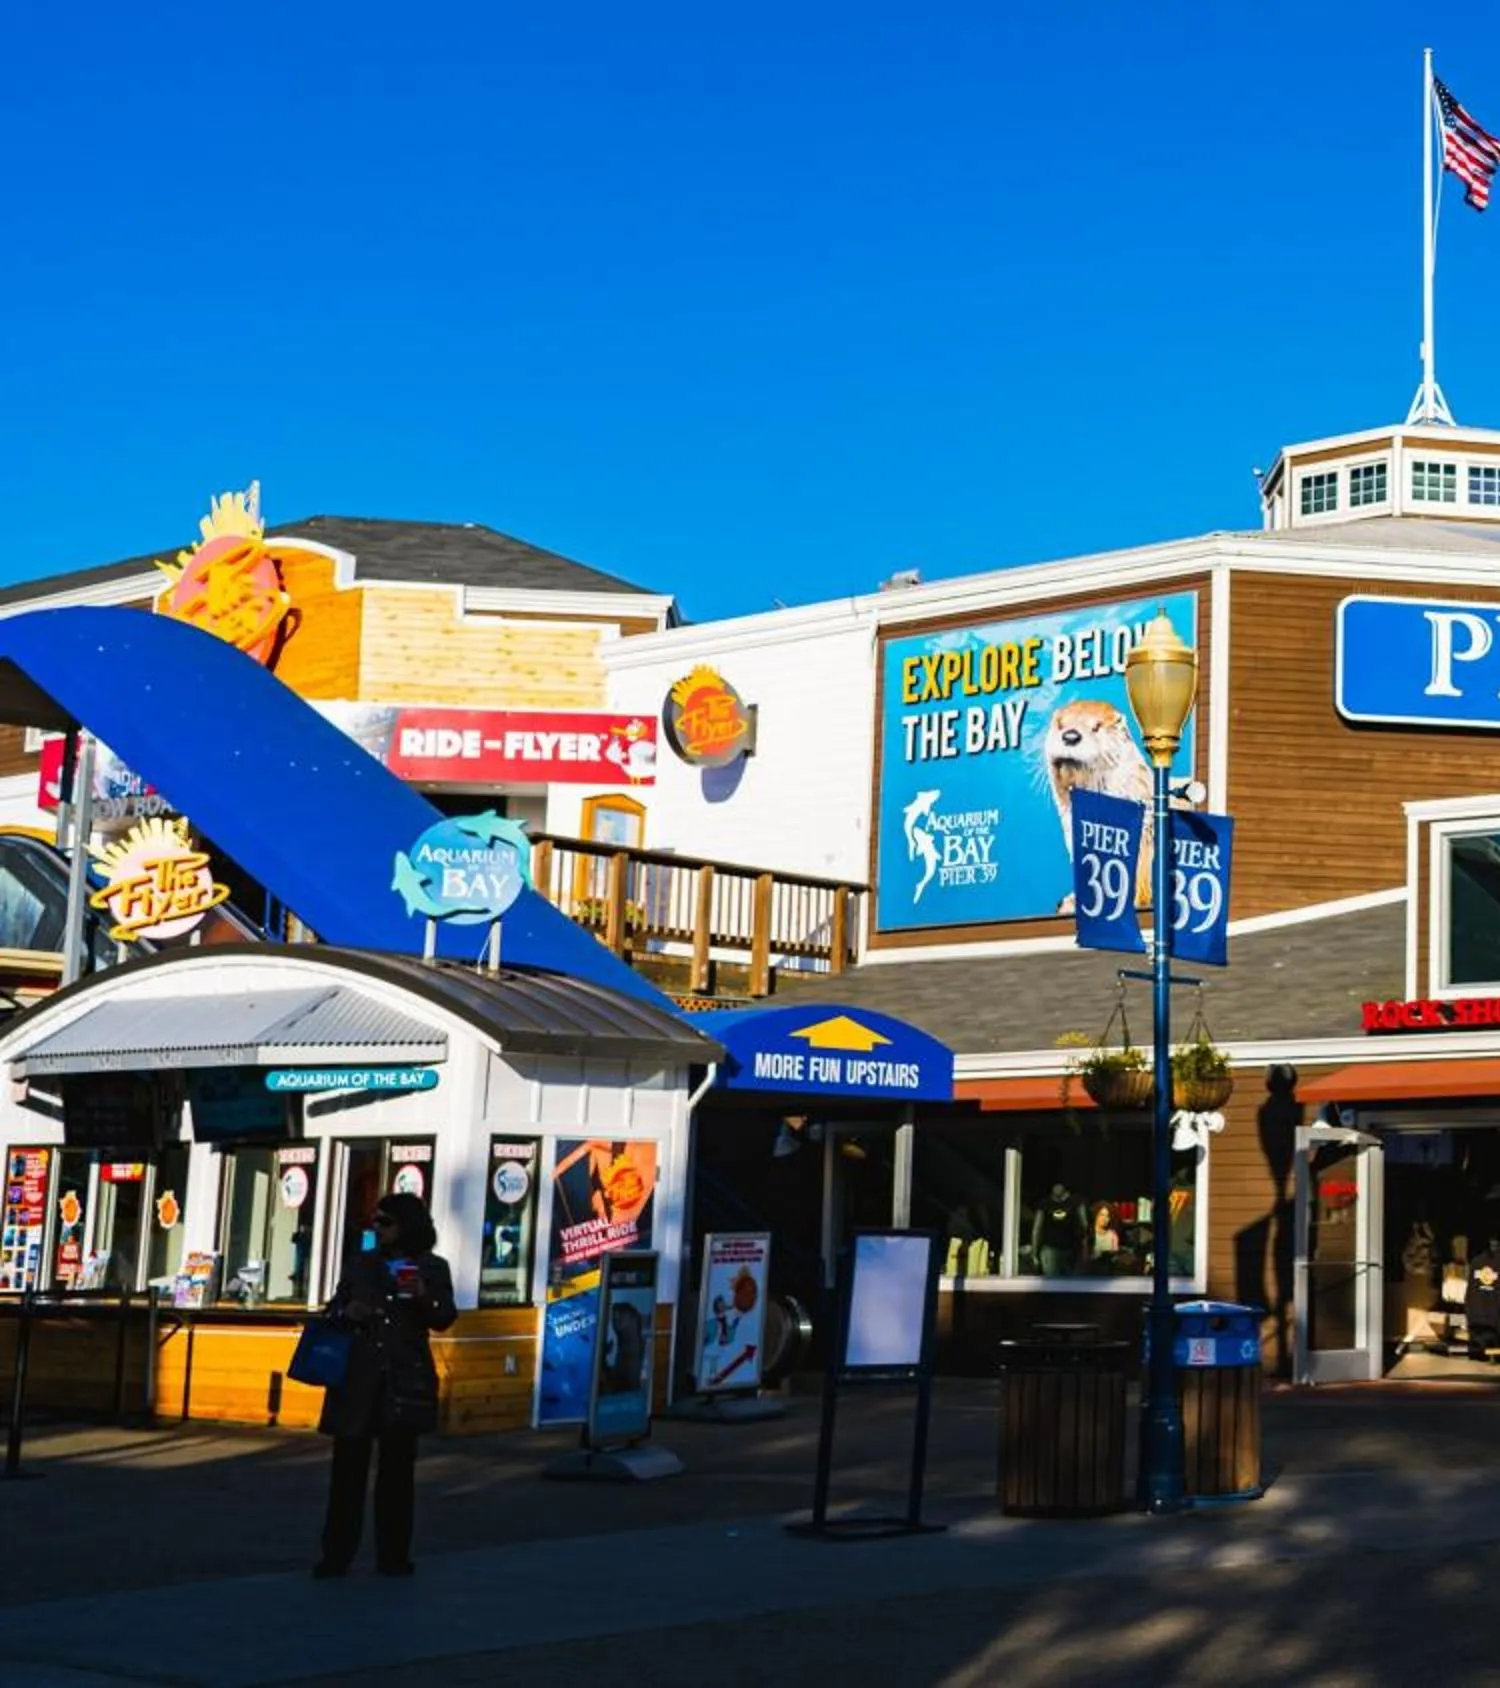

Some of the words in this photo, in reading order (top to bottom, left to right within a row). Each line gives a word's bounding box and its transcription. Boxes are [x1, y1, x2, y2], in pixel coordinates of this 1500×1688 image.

[902, 638, 1043, 704] EXPLORE
[902, 708, 959, 762] THE
[965, 700, 1028, 754] BAY
[925, 809, 999, 835] AQUARIUM
[1080, 819, 1131, 857] PIER
[416, 843, 515, 868] AQUARIUM
[943, 834, 996, 867] BAY
[143, 853, 209, 893] The
[442, 868, 510, 898] BAY
[938, 867, 977, 887] PIER
[980, 865, 998, 884] 39
[1080, 853, 1130, 922] 39
[91, 874, 230, 925] Flyer
[1361, 999, 1443, 1030] ROCK
[277, 1072, 350, 1088] AQUARIUM
[351, 1072, 369, 1087] OF
[373, 1071, 399, 1086] THE
[401, 1071, 426, 1086] BAY
[754, 1052, 805, 1081] MORE
[809, 1056, 841, 1084] FUN
[846, 1059, 920, 1089] UPSTAIRS
[559, 1216, 613, 1241] VIRTUAL
[562, 1229, 606, 1254] THRILL
